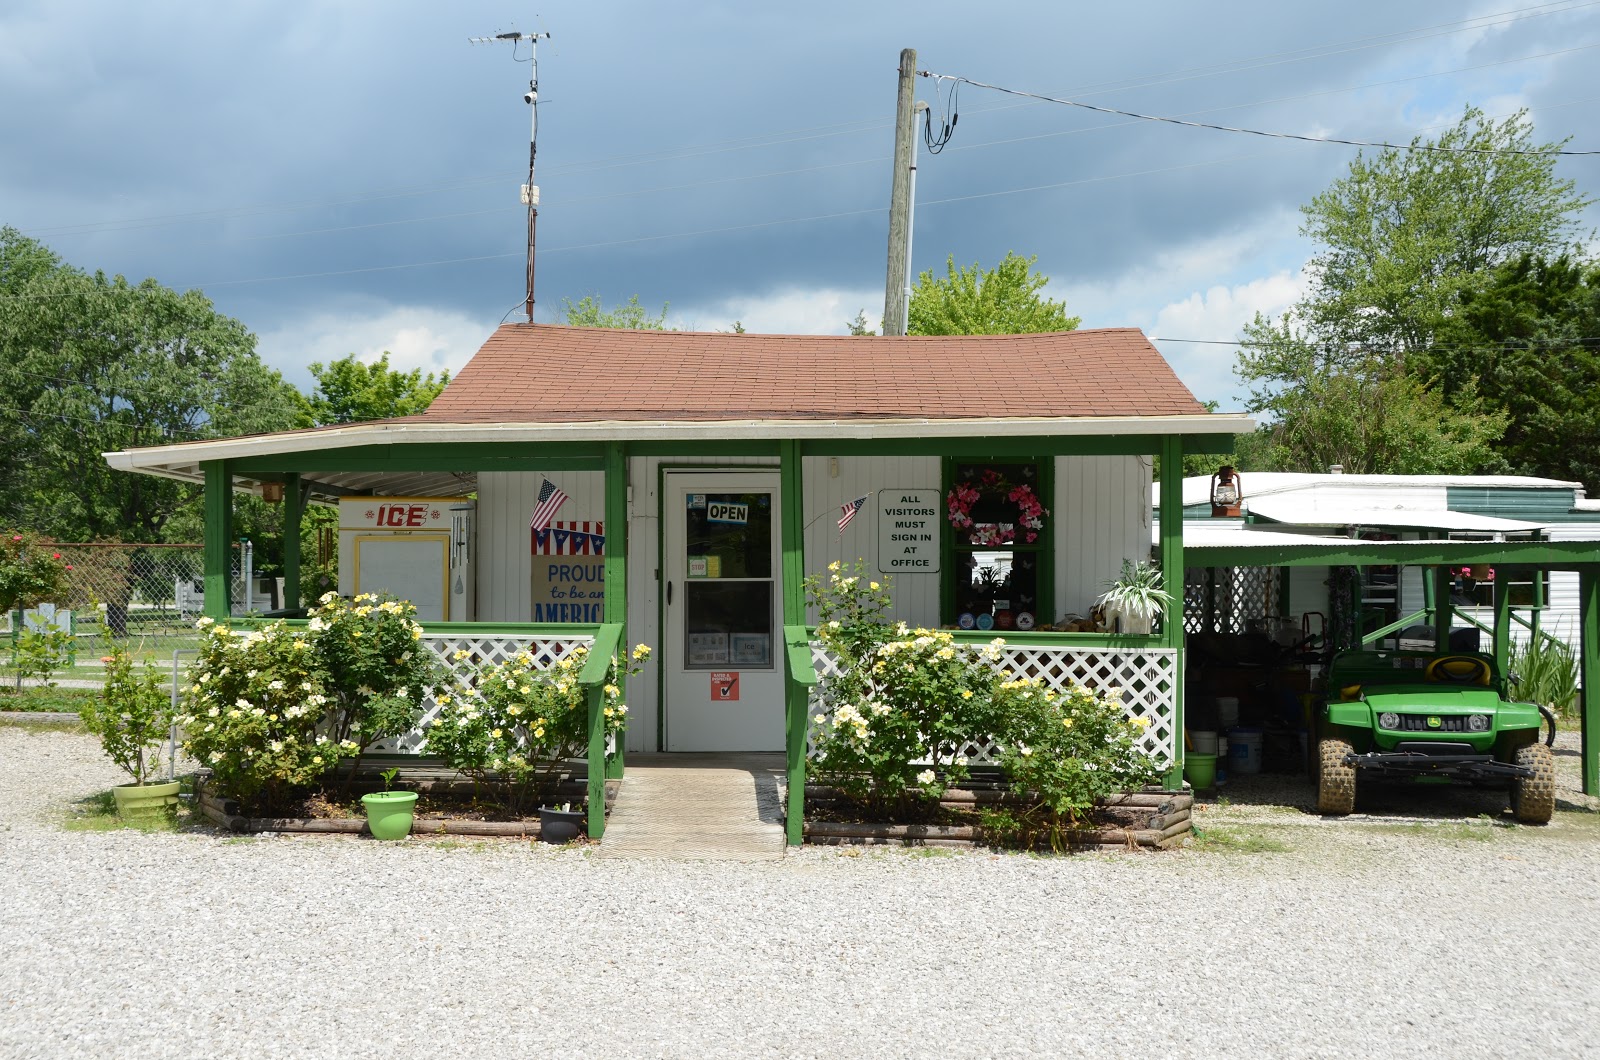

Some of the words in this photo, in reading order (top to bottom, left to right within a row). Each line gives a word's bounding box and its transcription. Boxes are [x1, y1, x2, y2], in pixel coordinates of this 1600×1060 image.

[377, 503, 429, 526] ICE
[710, 505, 746, 521] OPEN
[885, 508, 935, 516] VISITORS
[550, 586, 567, 598] to
[569, 585, 586, 599] be
[588, 590, 604, 599] an
